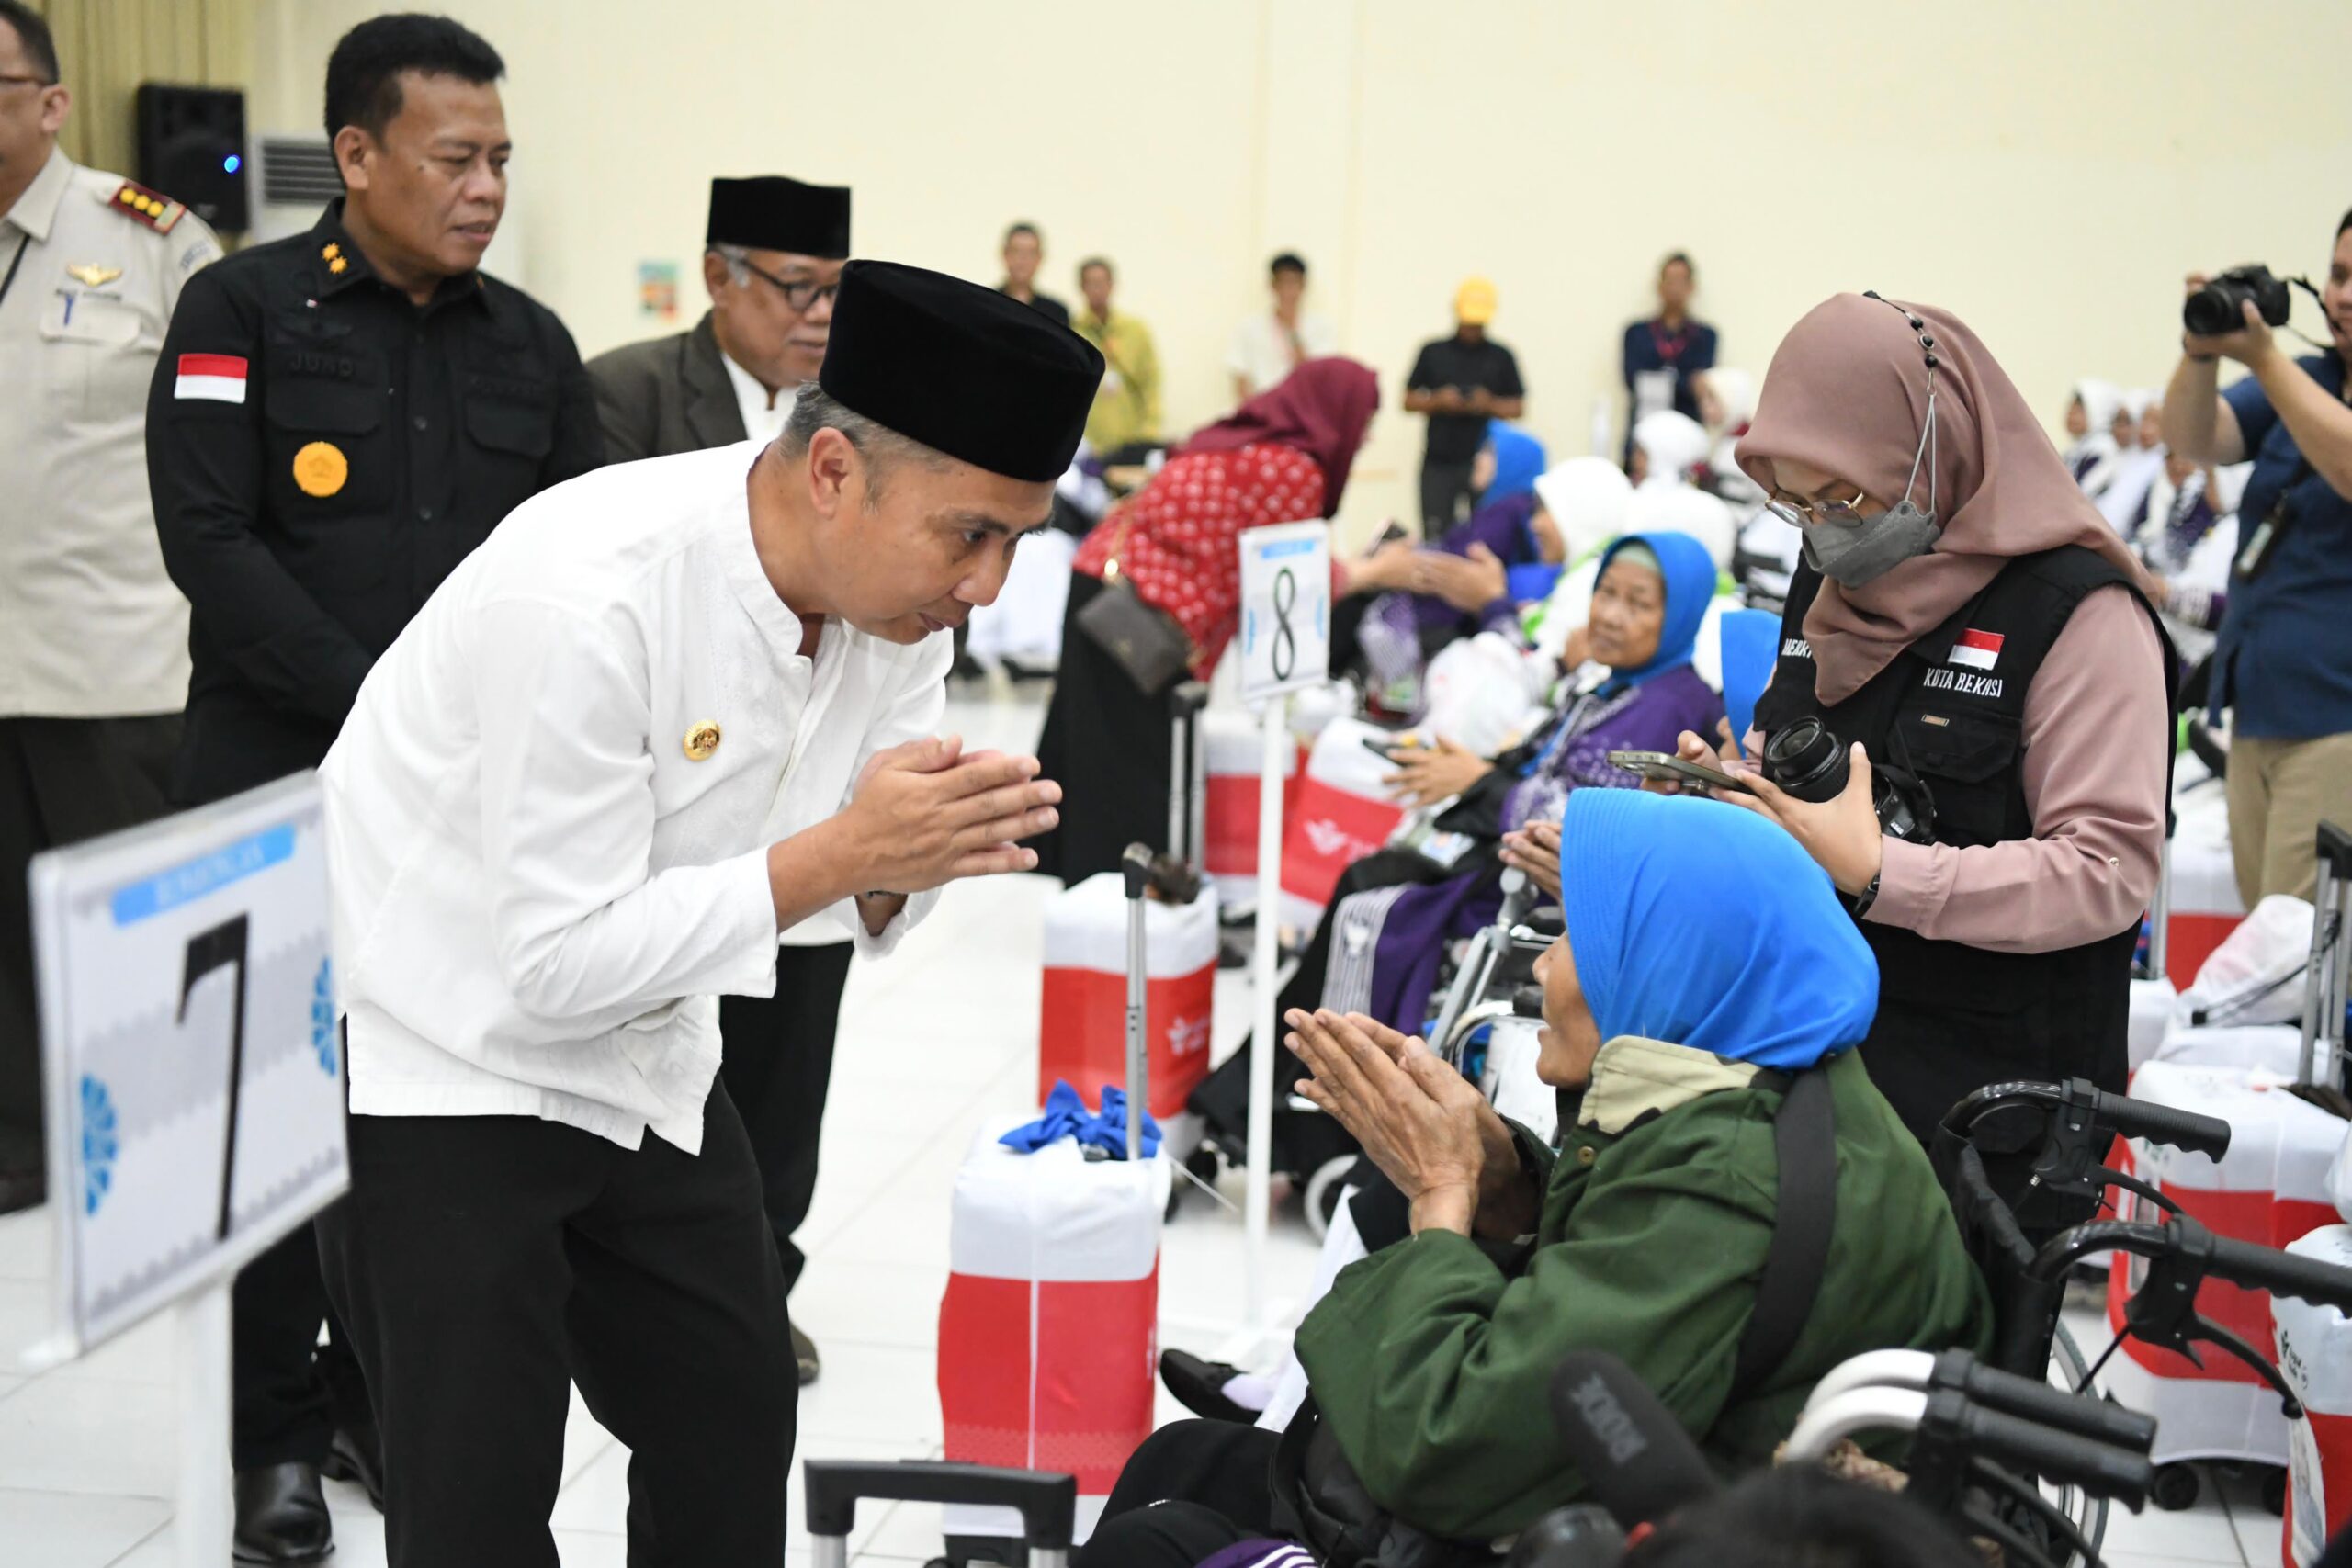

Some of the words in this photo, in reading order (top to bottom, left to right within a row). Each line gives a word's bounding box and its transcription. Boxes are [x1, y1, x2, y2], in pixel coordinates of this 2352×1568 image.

[1272, 567, 1296, 682] 8
[1923, 667, 1954, 690] KOTA
[1954, 671, 2003, 698] BEKASI
[175, 913, 250, 1240] 7
